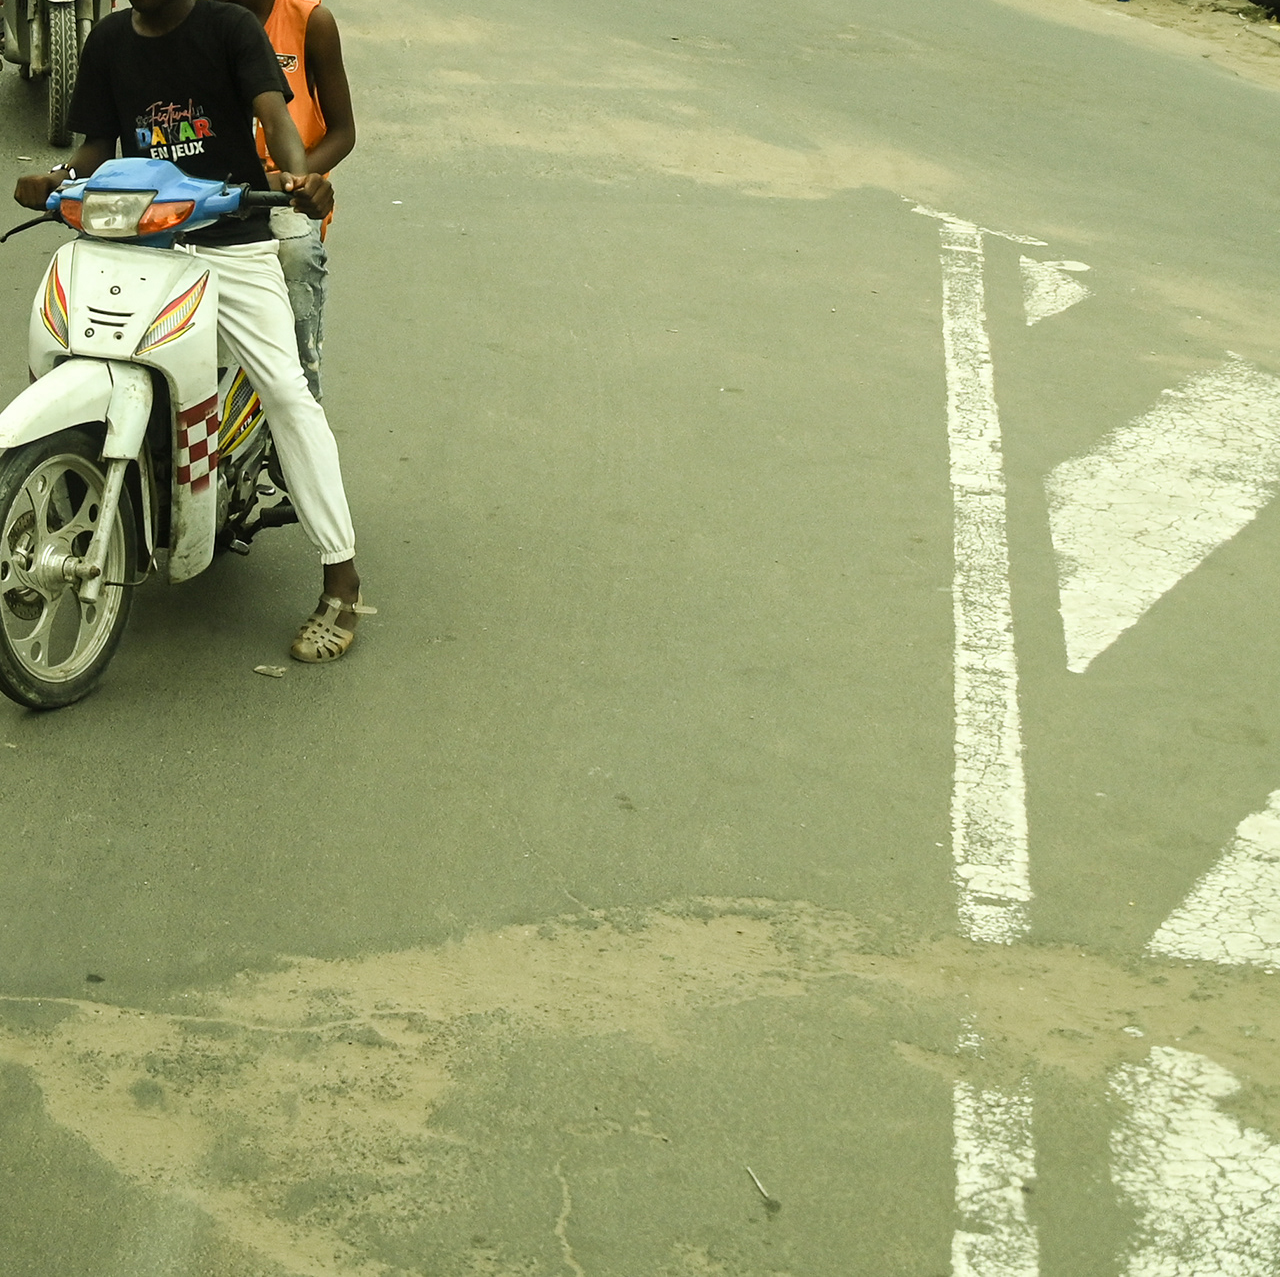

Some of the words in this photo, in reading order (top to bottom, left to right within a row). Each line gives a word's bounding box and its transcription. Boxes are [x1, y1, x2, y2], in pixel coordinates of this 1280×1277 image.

[136, 117, 213, 147] DAKAR
[150, 147, 170, 160] EN
[171, 141, 205, 162] JEUX
